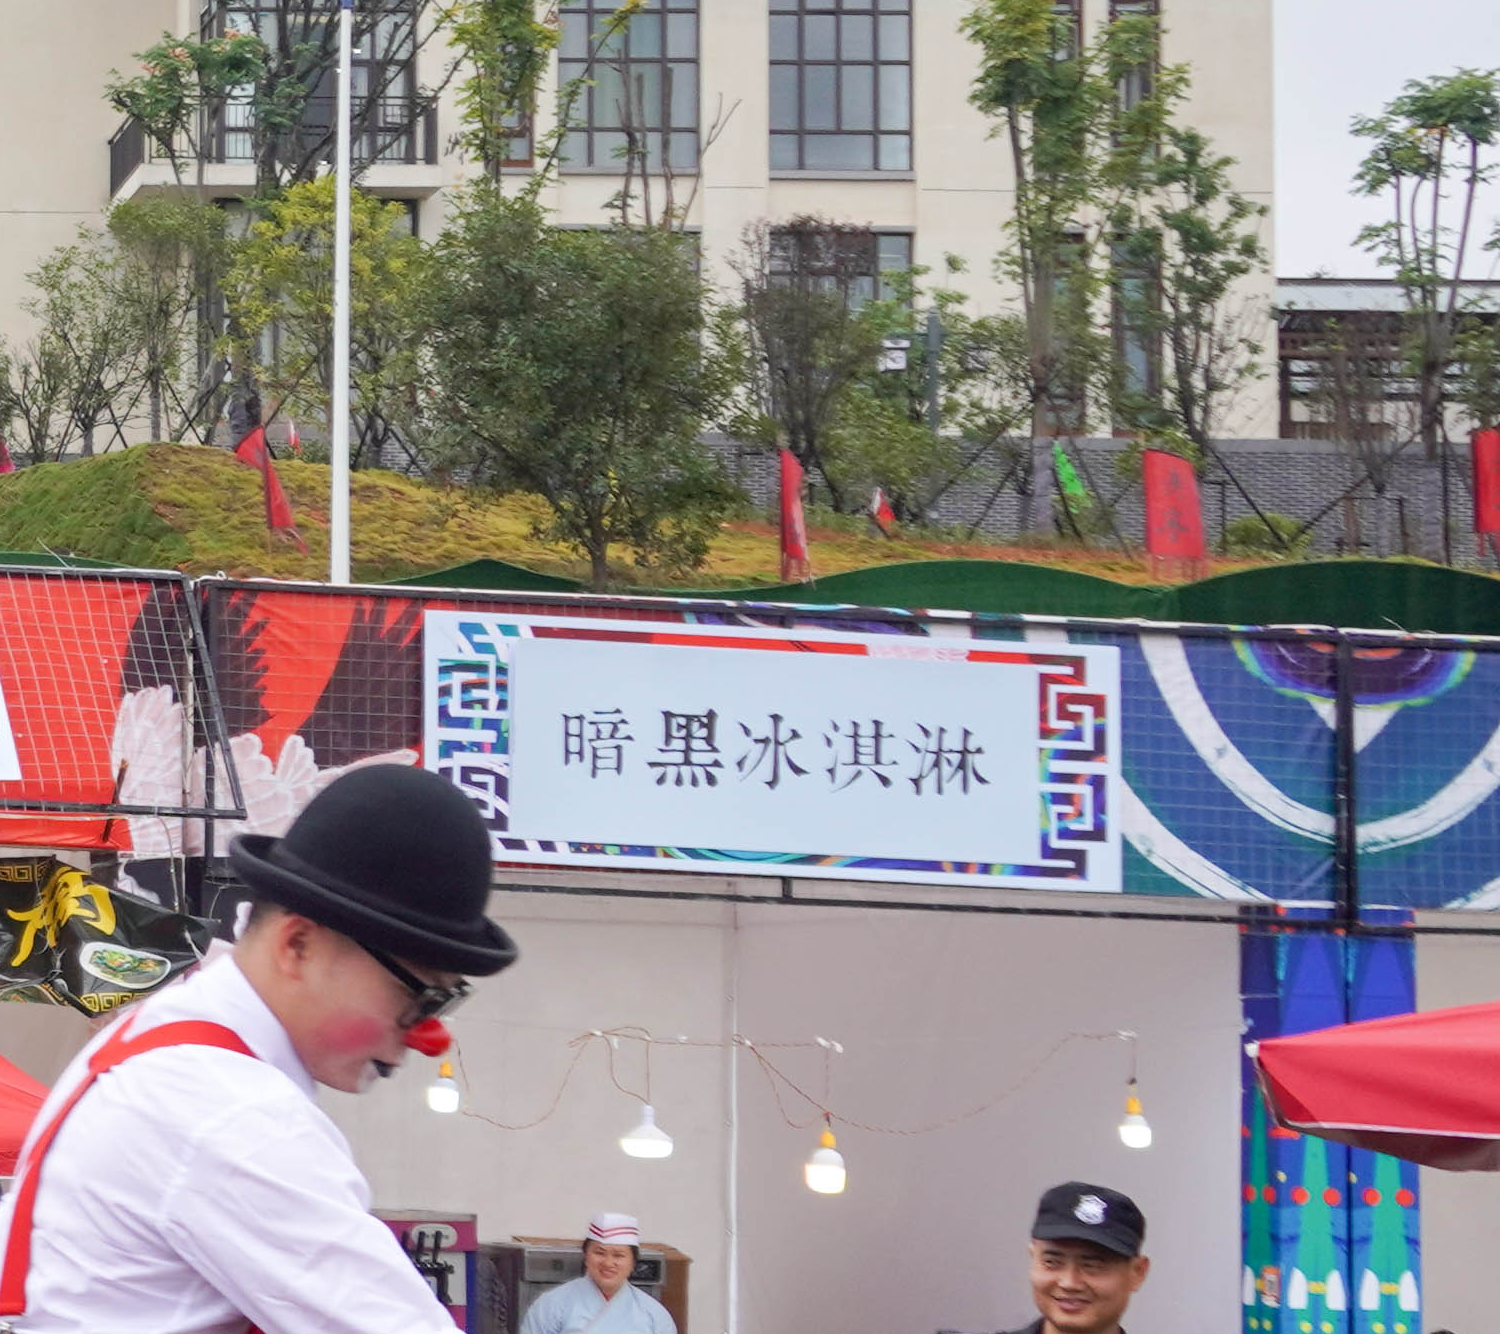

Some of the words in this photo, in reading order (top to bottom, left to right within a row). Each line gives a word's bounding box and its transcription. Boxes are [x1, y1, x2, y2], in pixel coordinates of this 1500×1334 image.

[560, 707, 991, 798] 暗黑冰淇淋
